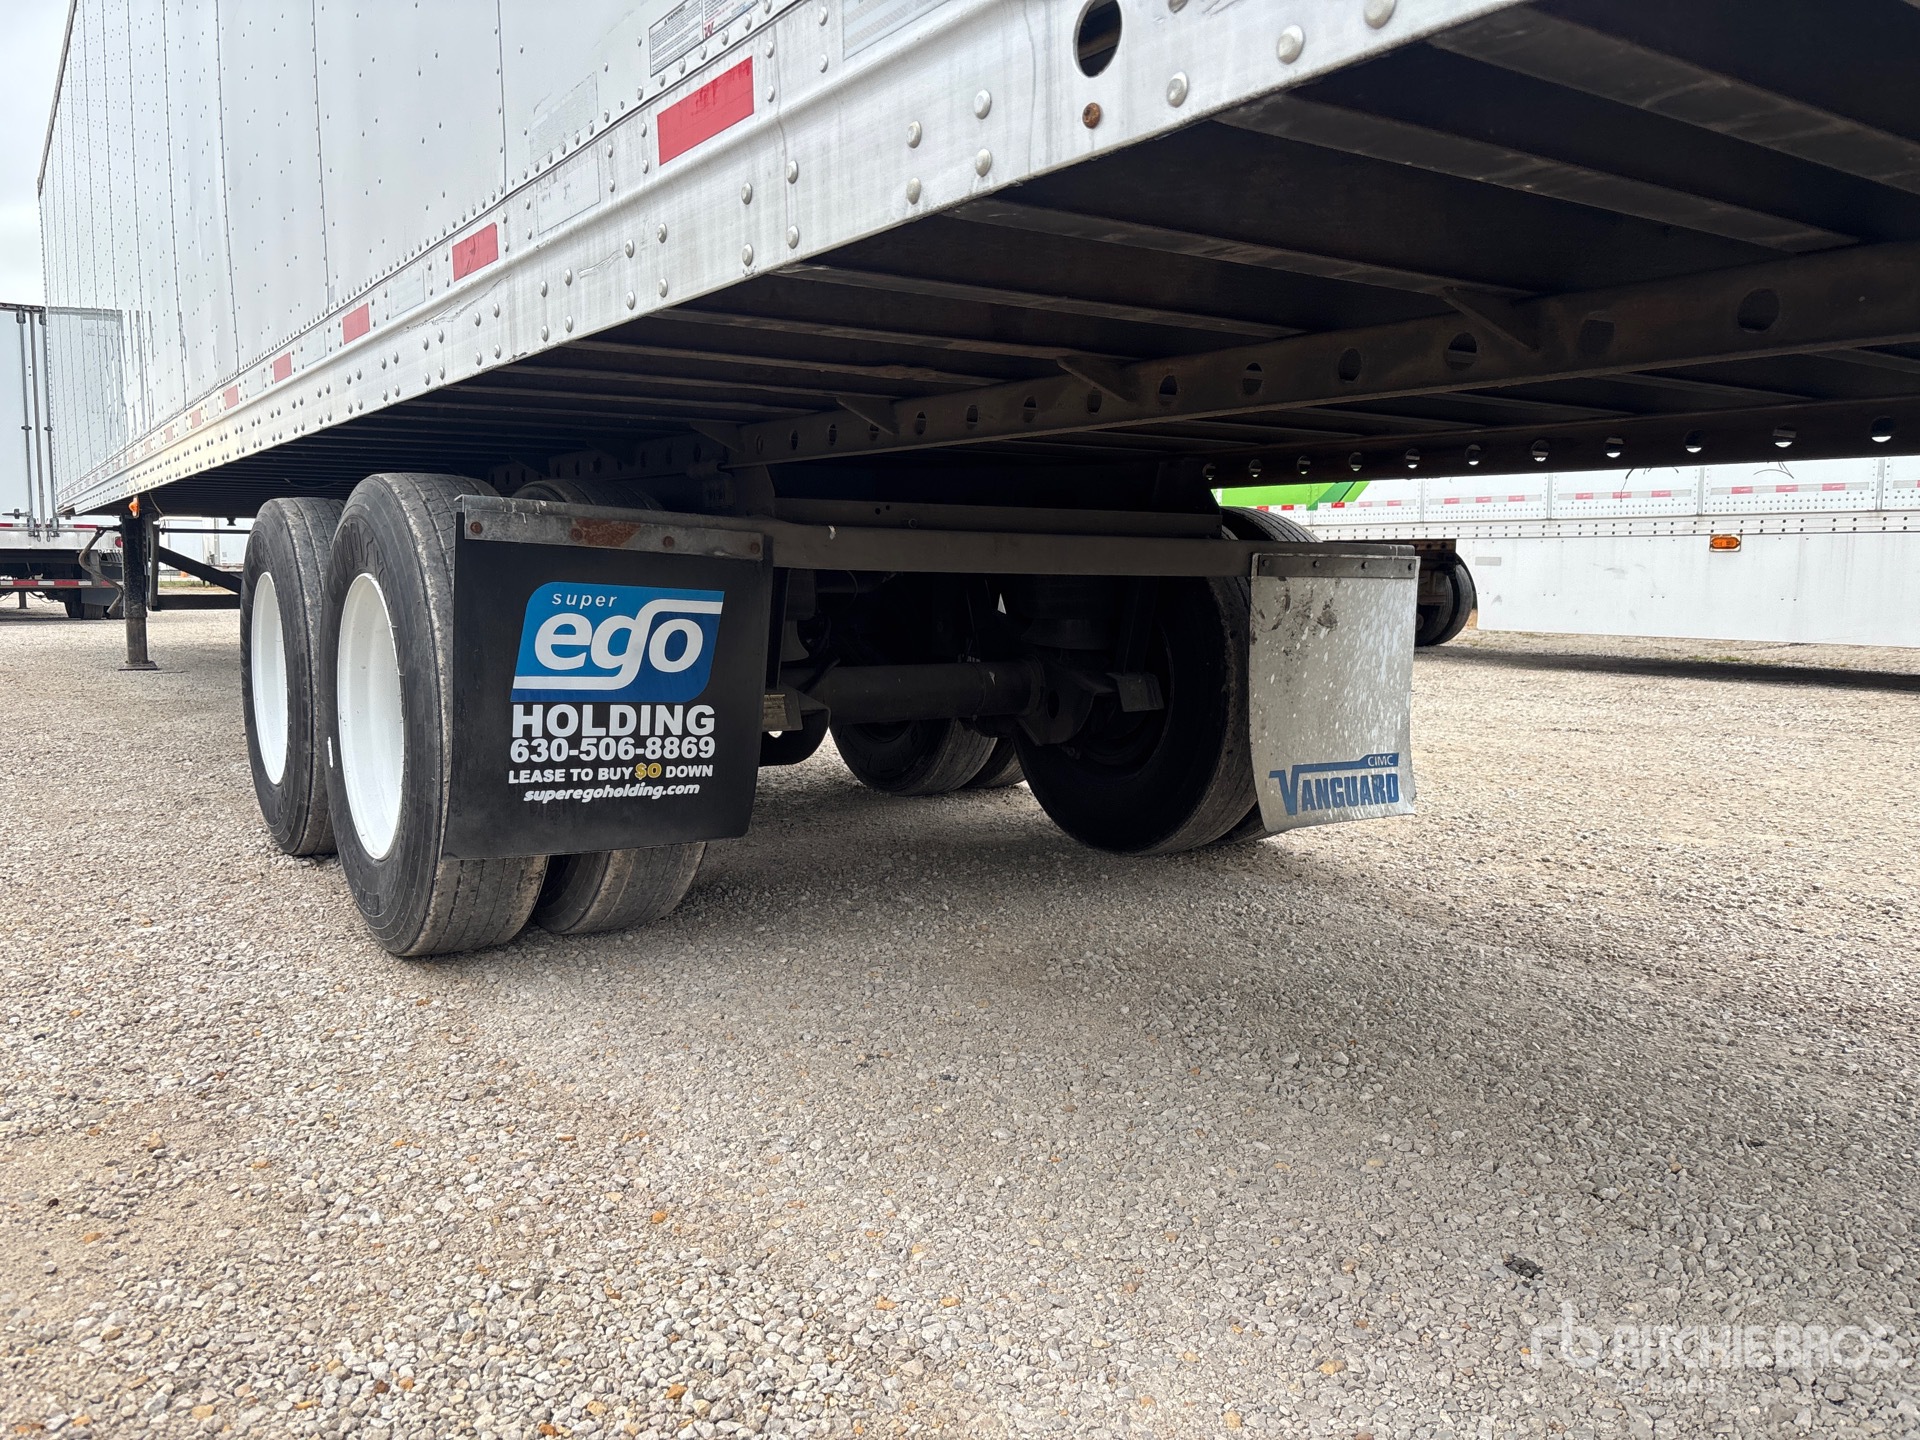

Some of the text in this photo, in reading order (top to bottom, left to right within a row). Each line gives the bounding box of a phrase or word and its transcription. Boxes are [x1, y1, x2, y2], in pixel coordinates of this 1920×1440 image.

[551, 591, 618, 610] super
[530, 600, 708, 690] ego
[512, 704, 715, 737] HOLDING
[510, 737, 716, 763] 630-506-8869
[1367, 755, 1394, 767] CIMC
[508, 762, 714, 784] LEASE TO BUY $0 DOWN
[523, 782, 700, 804] superegoholding.com
[1269, 763, 1400, 816] VANGUARD
